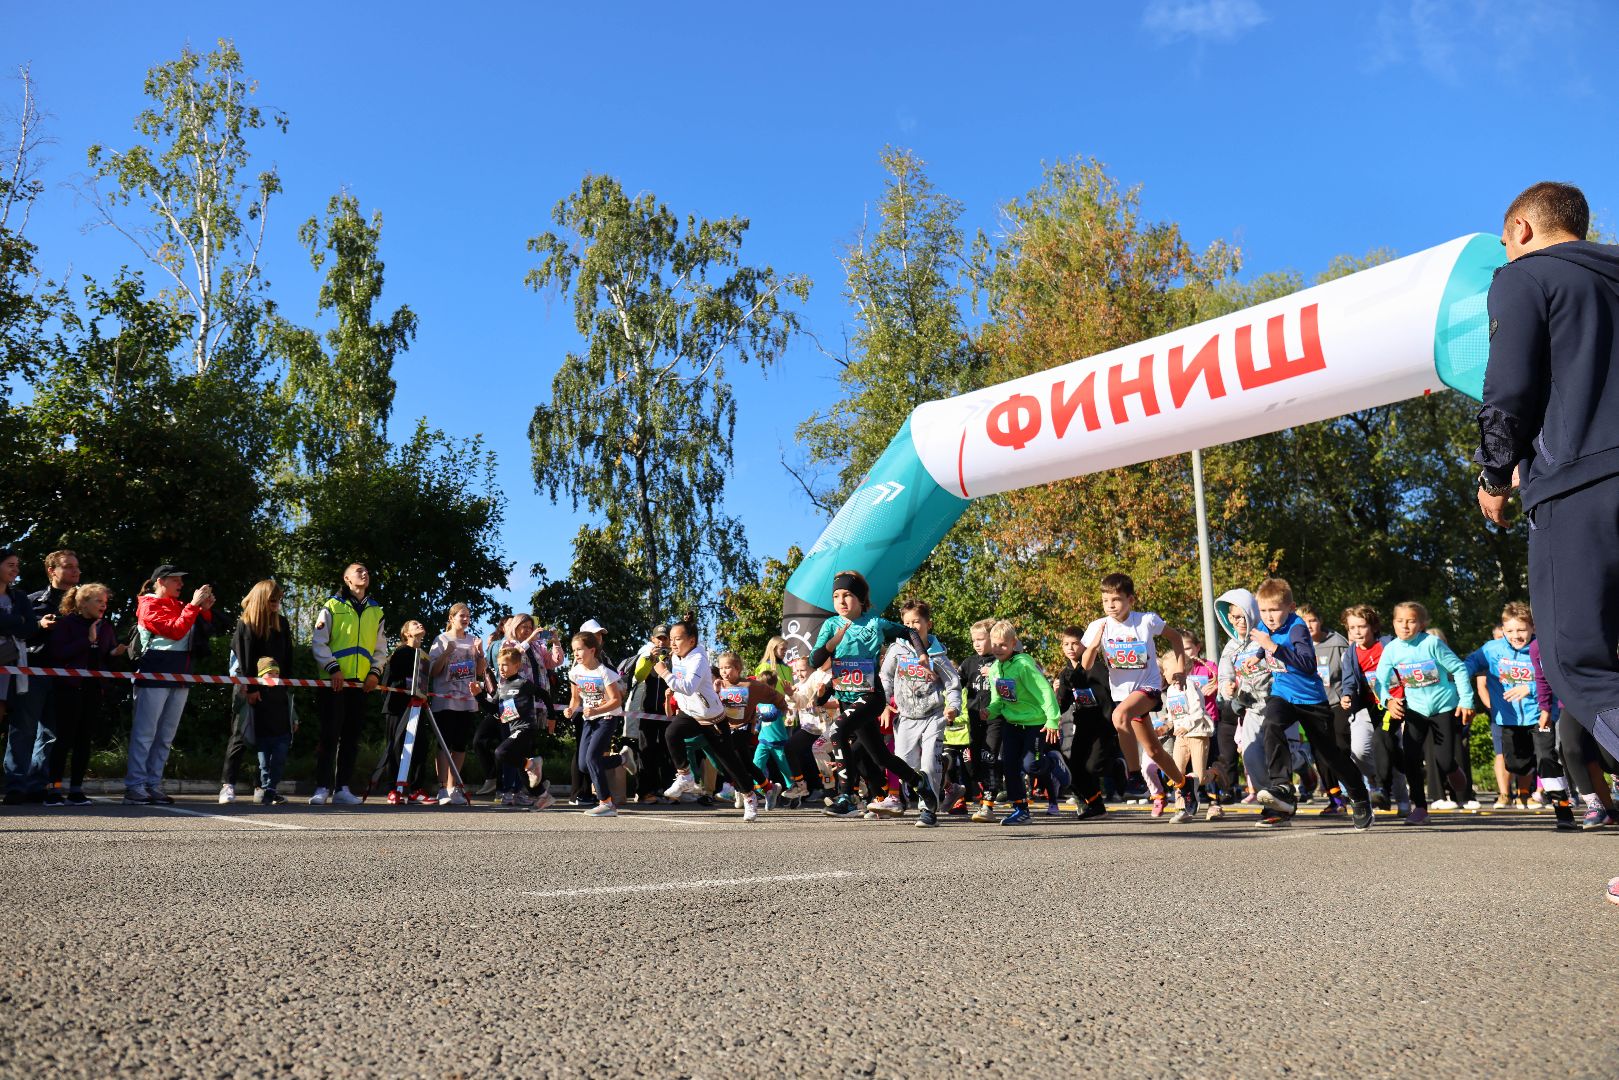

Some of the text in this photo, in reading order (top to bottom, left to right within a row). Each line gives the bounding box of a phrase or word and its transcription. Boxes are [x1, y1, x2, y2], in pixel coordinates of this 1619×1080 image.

[985, 303, 1327, 451] ФИНИШ
[1116, 650, 1137, 664] 56
[840, 669, 864, 685] 20
[908, 664, 925, 677] 55
[1412, 669, 1425, 682] 5
[1510, 666, 1532, 680] 32
[583, 681, 598, 693] 21
[727, 692, 742, 703] 26
